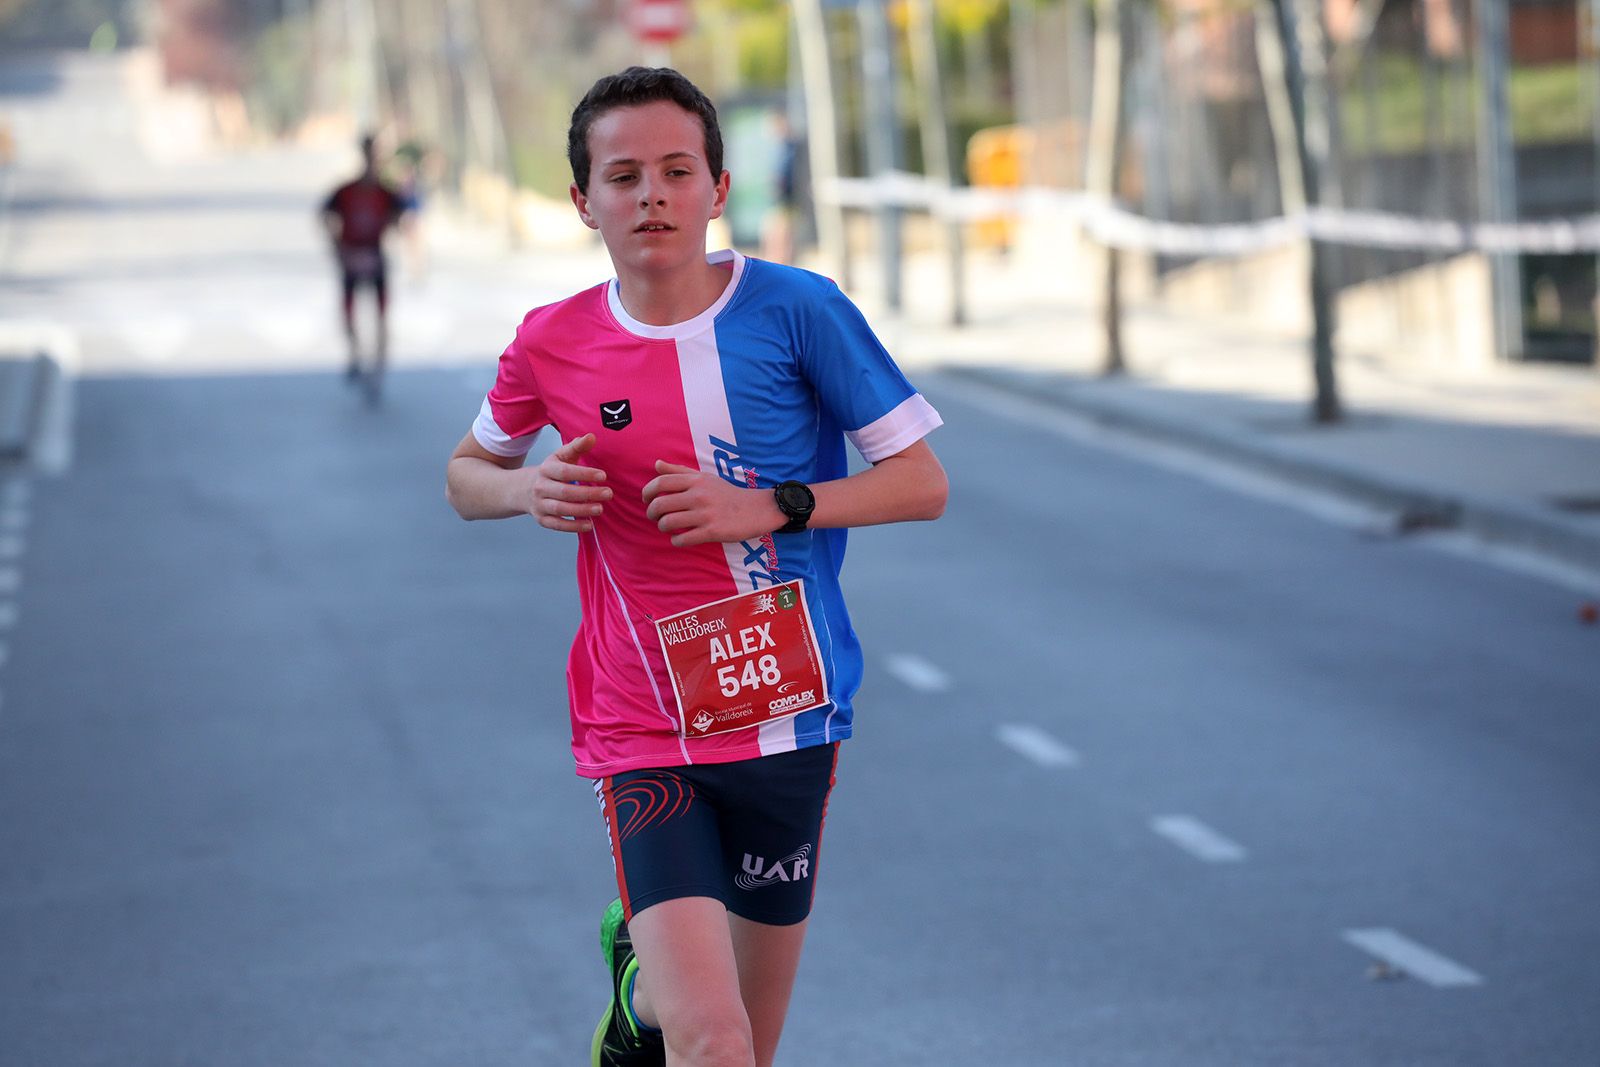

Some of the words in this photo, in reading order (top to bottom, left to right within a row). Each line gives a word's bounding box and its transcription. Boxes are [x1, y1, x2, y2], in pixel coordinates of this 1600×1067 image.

[783, 594, 789, 603] 1
[662, 615, 698, 636] MILLES
[665, 618, 726, 646] VALLDOREIX
[710, 621, 776, 665] ALEX
[716, 654, 782, 698] 548
[768, 688, 815, 710] COMPLEX
[715, 708, 754, 722] Valldoreix
[741, 852, 810, 882] UAR
